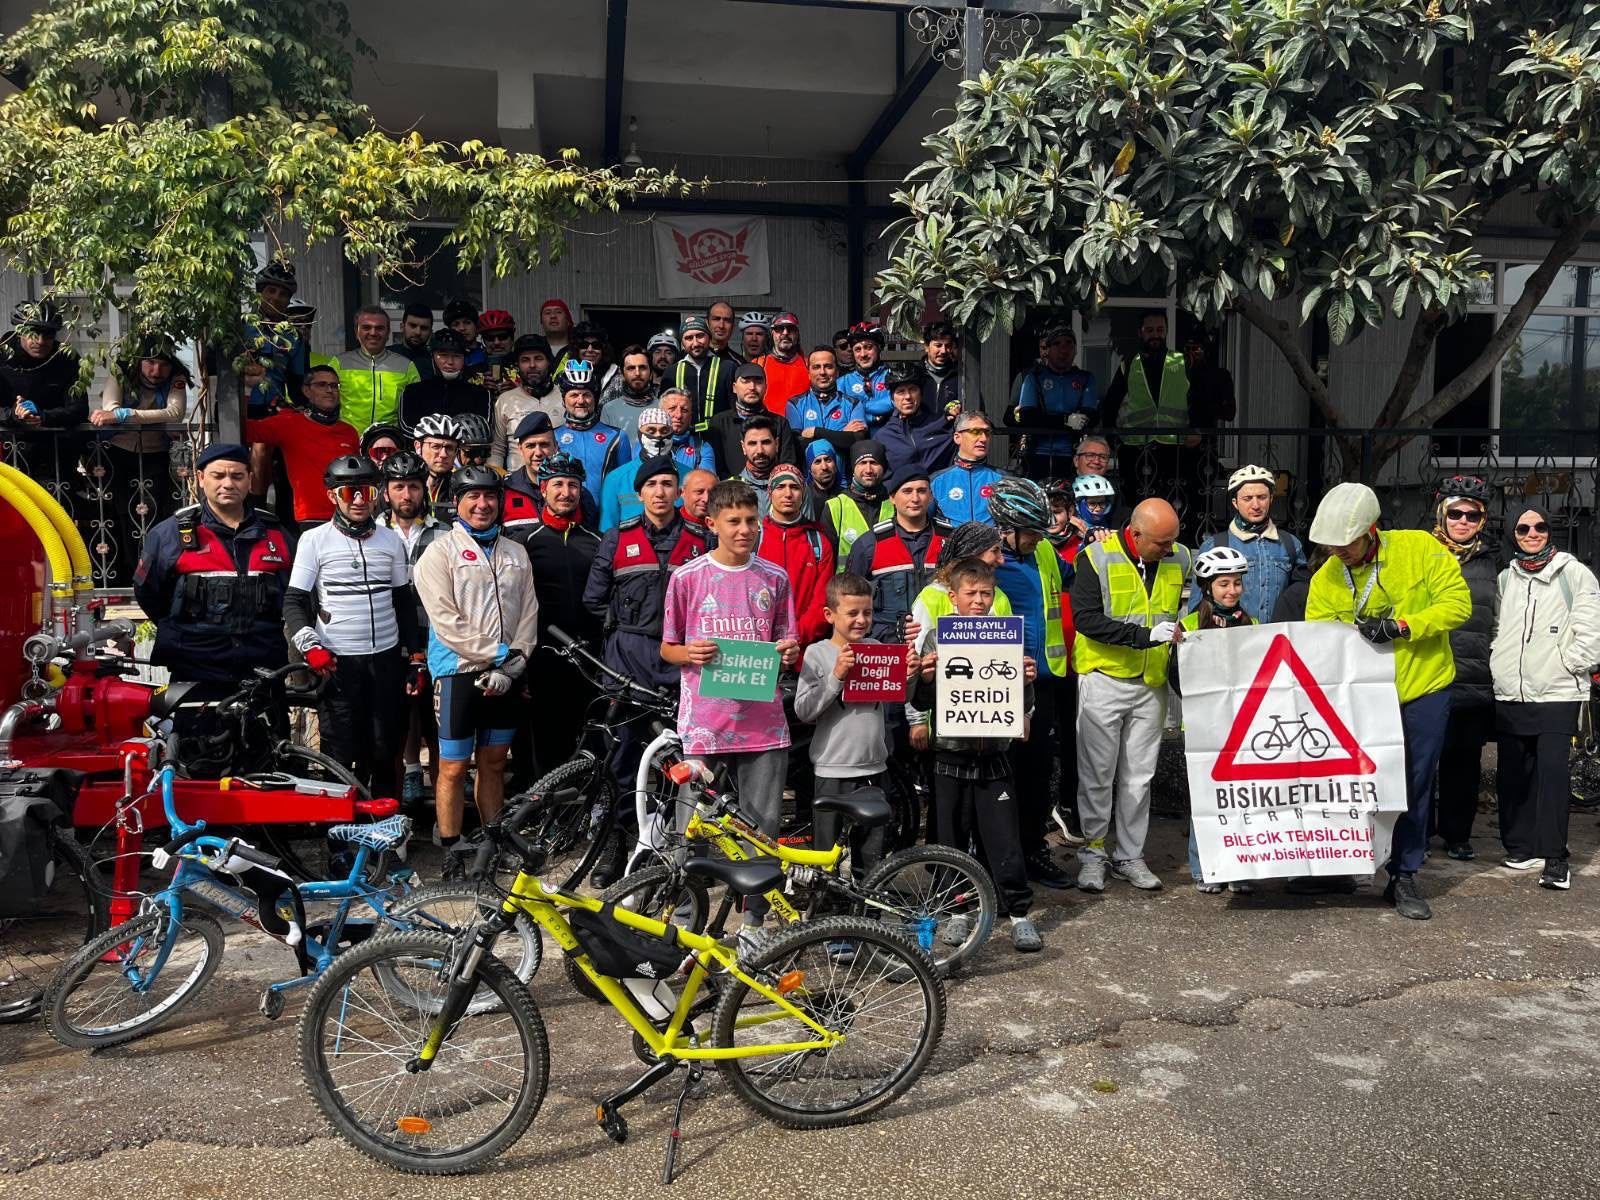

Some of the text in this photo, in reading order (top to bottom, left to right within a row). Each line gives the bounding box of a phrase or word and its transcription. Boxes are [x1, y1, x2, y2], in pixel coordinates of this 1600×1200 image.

[700, 613, 769, 633] Emirates
[952, 621, 1006, 630] 2918 SAYILI
[942, 629, 1017, 640] KANUN GEREĞİ
[711, 653, 774, 670] Bisikleti
[855, 652, 900, 666] Kornaya
[712, 669, 767, 685] Fark Et
[861, 666, 890, 679] Değil
[849, 680, 902, 691] Frene Bas
[950, 688, 1009, 706] ŞERİDİ
[946, 710, 1014, 726] PAYLAŞ
[1216, 779, 1378, 809] BİSİKLETLİLER
[1223, 830, 1283, 848] BİLECİK
